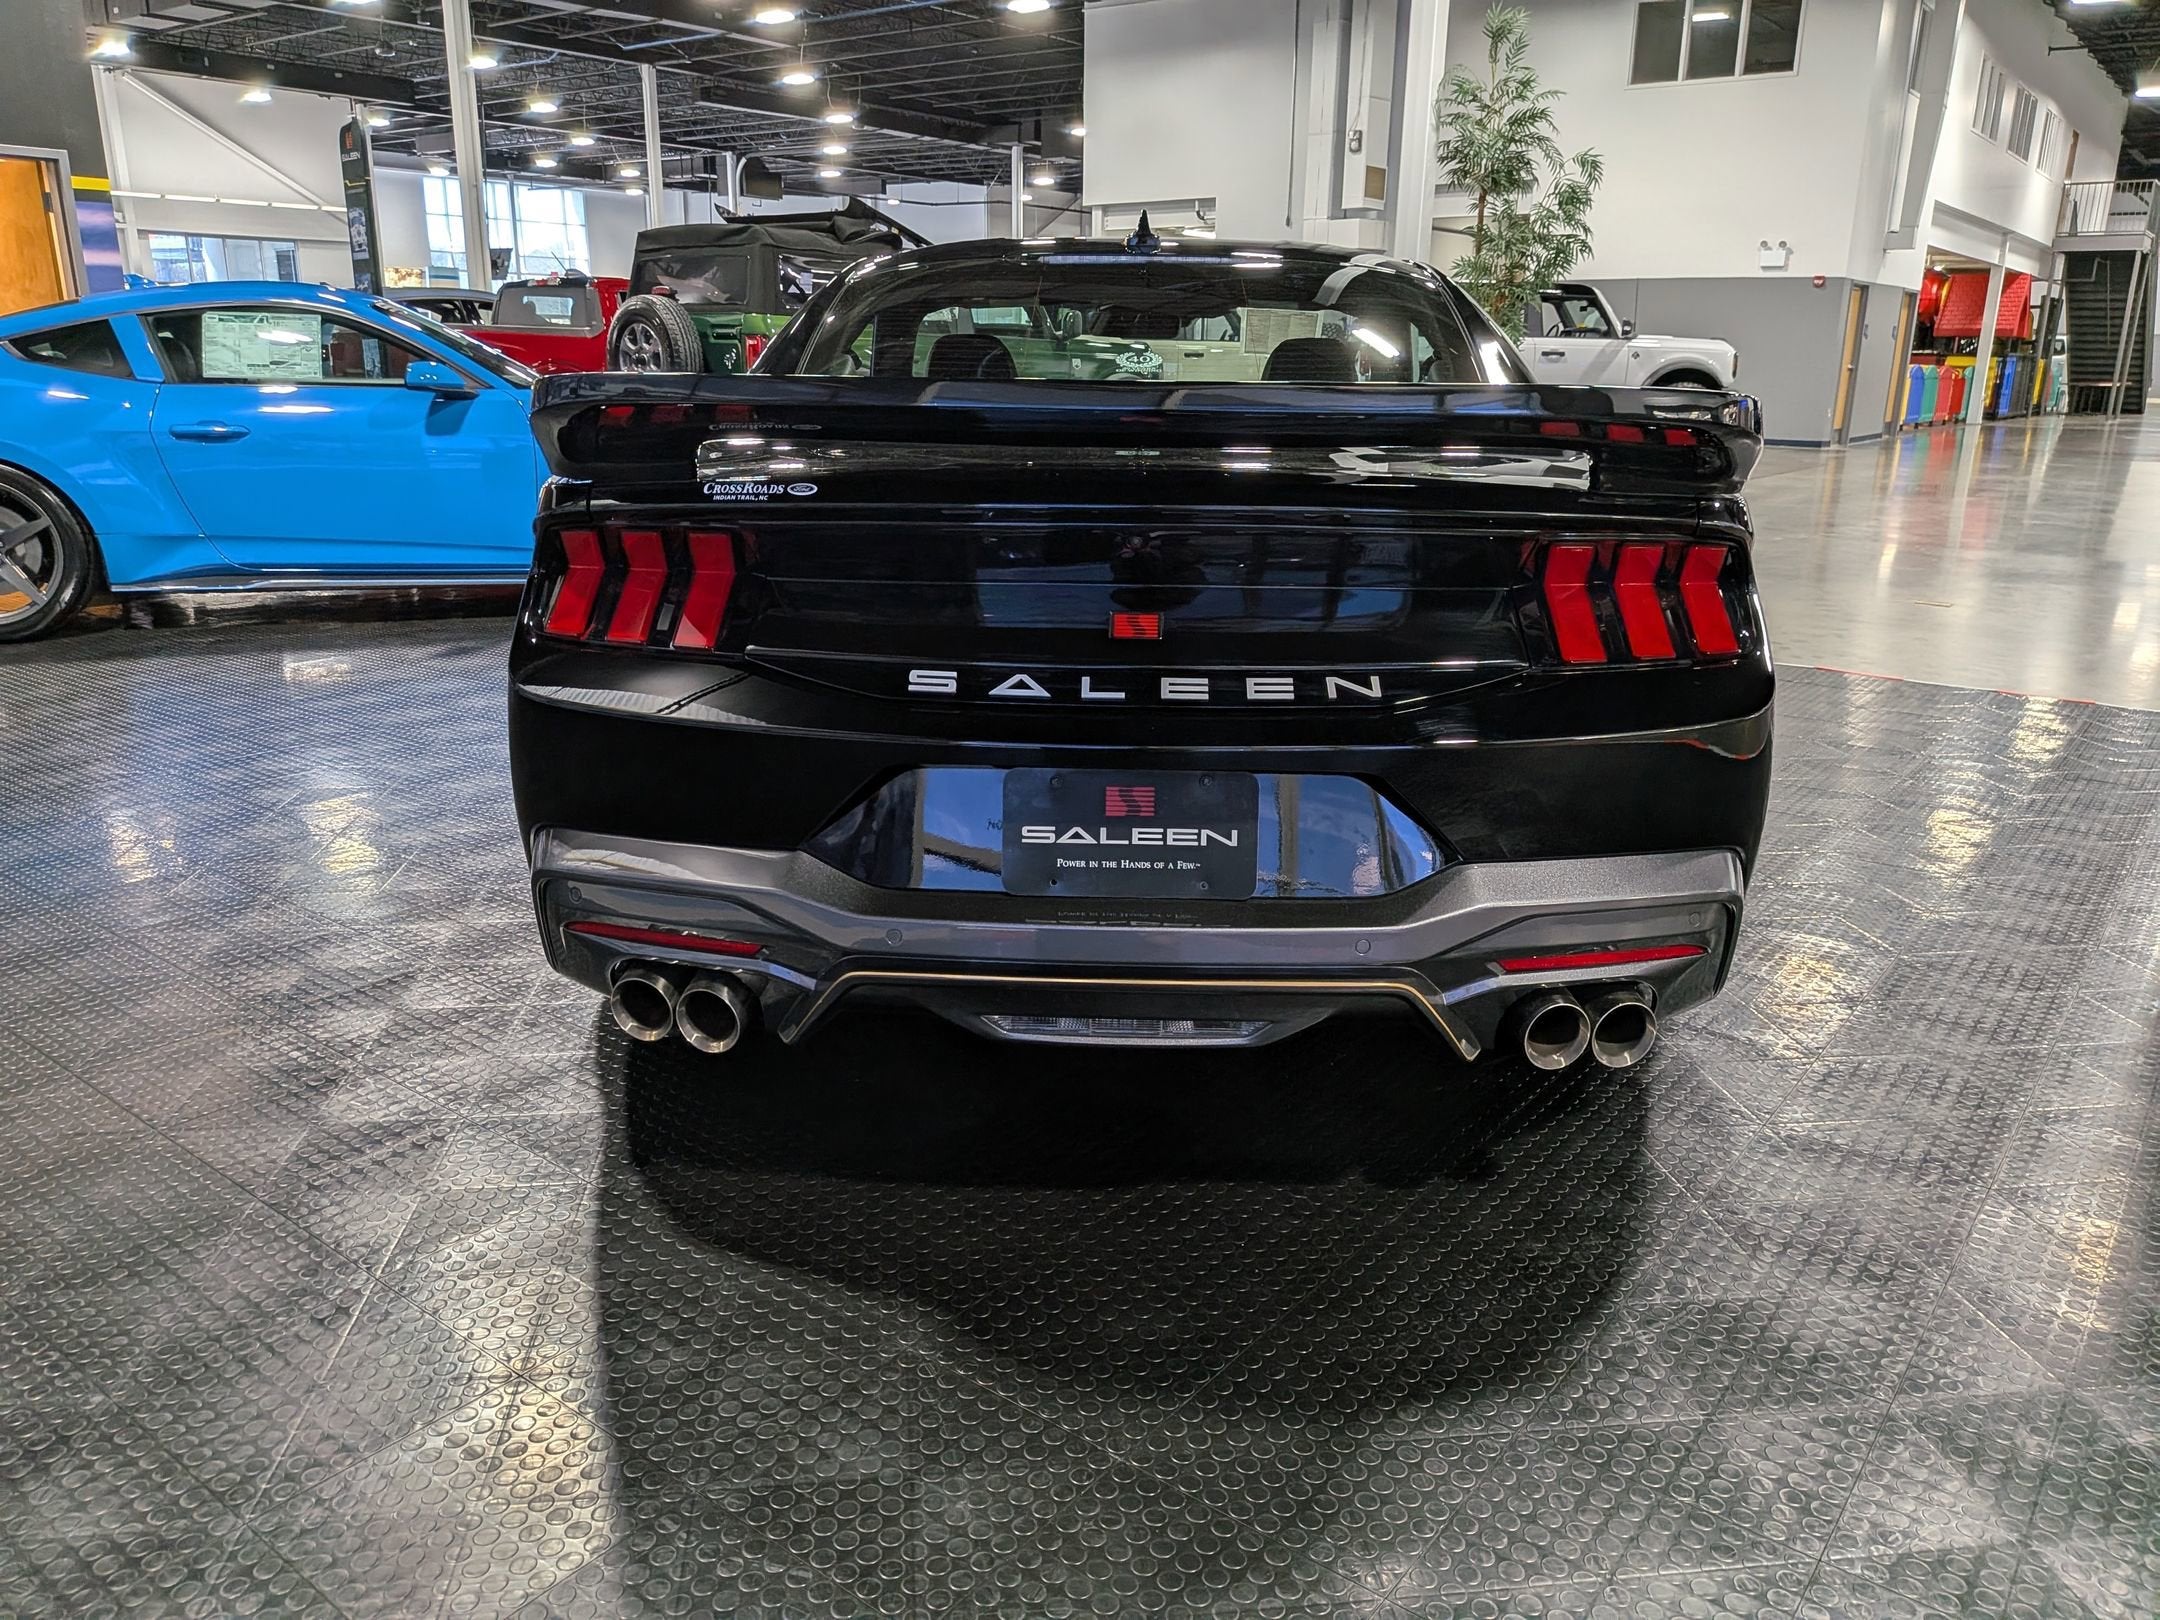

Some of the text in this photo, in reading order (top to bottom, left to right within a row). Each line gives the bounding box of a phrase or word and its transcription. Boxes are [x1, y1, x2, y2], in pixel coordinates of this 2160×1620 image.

[1128, 355, 1151, 363] 40
[907, 669, 1382, 700] SALEEN
[1021, 825, 1239, 847] SALEEN
[1168, 861, 1174, 869] A
